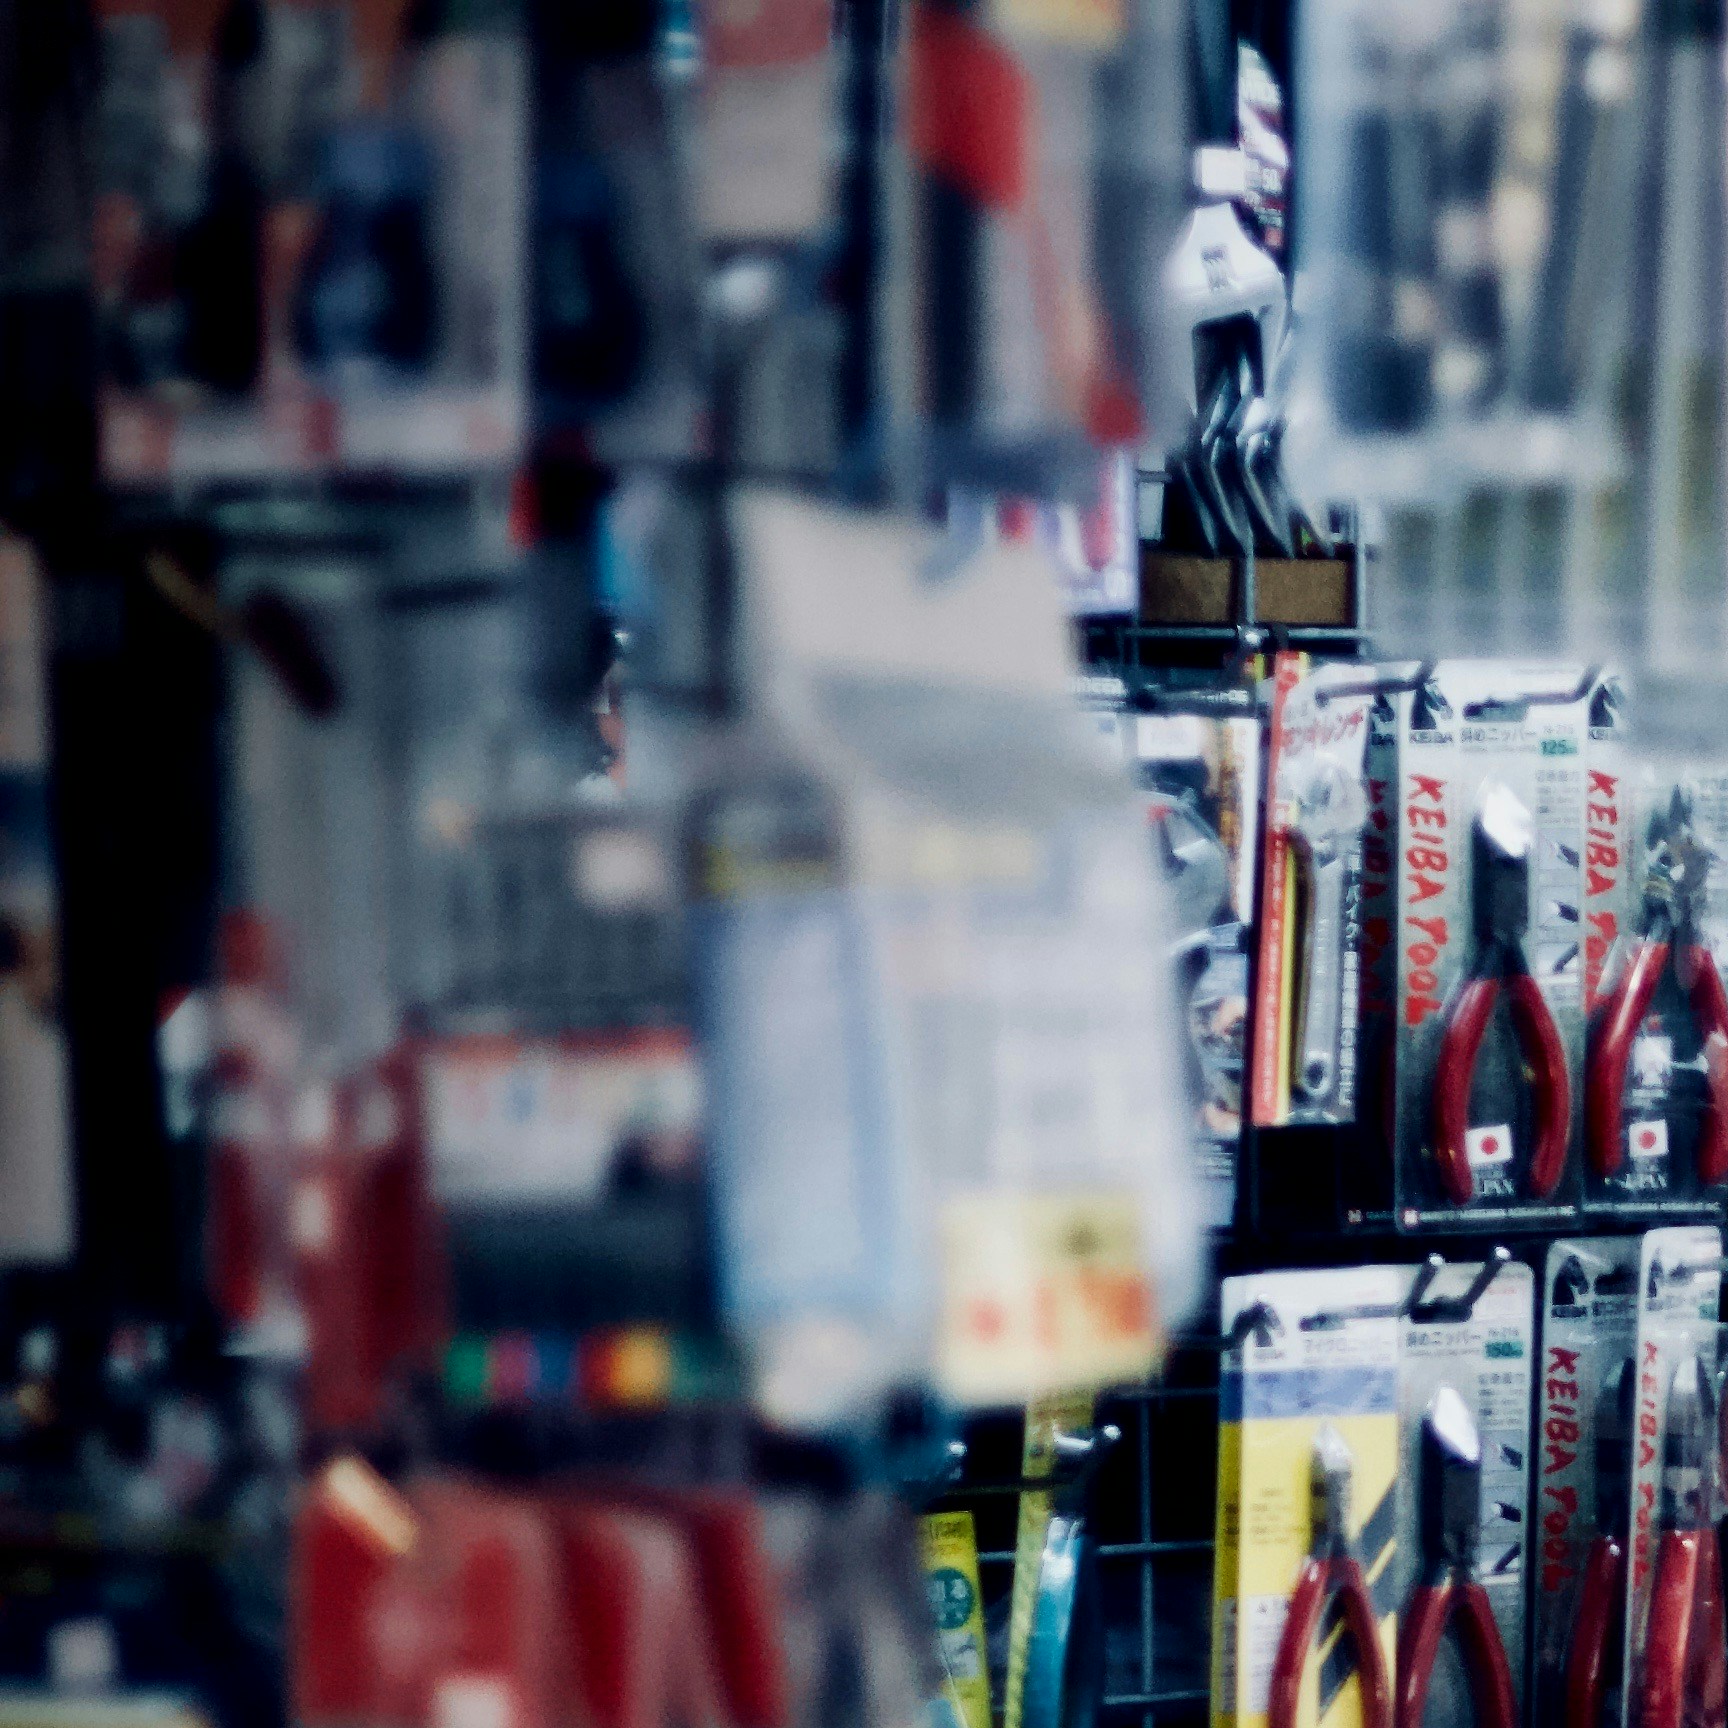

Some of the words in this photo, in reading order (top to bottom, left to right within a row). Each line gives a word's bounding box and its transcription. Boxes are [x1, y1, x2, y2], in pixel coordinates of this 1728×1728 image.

[1408, 774, 1448, 903] KEIBA
[1587, 770, 1620, 896] KEIBA
[1544, 1346, 1580, 1473] KEIBA
[1636, 1342, 1657, 1473] KEIBA
